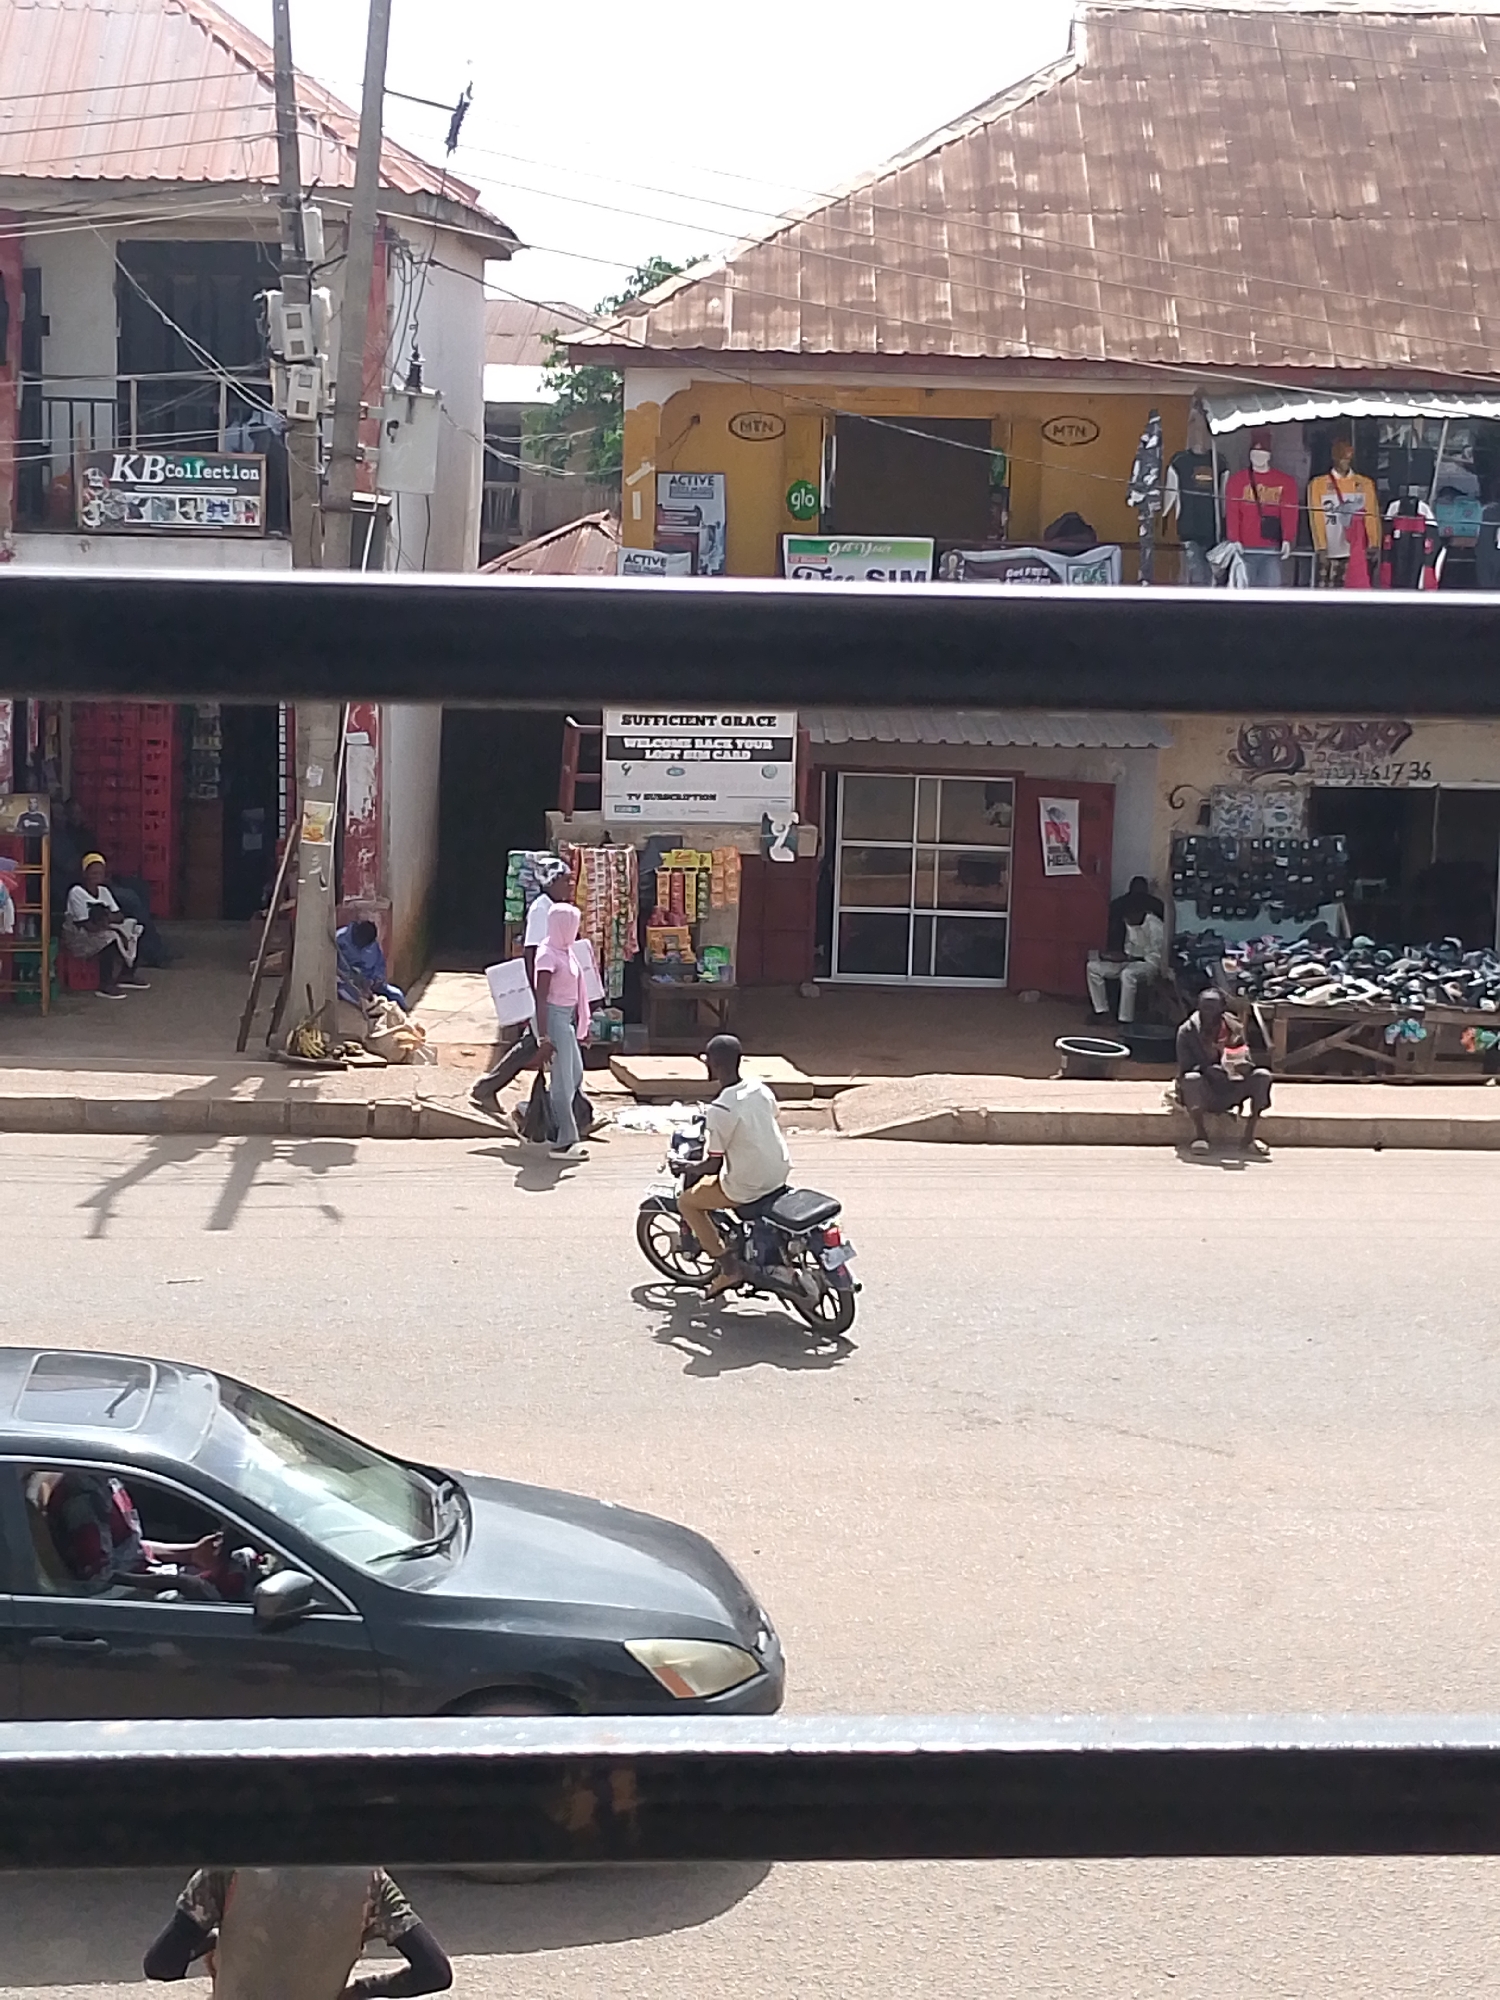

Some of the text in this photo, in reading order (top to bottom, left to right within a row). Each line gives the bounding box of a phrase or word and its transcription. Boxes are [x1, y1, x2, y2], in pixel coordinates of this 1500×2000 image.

[740, 420, 774, 433] MTN
[1053, 425, 1087, 437] MTN
[110, 454, 260, 483] KB Collection
[670, 475, 714, 487] ACTIVE
[791, 488, 814, 511] glo
[625, 553, 667, 567] ACTIVE
[621, 714, 777, 728] SUFFICIENT GRACE
